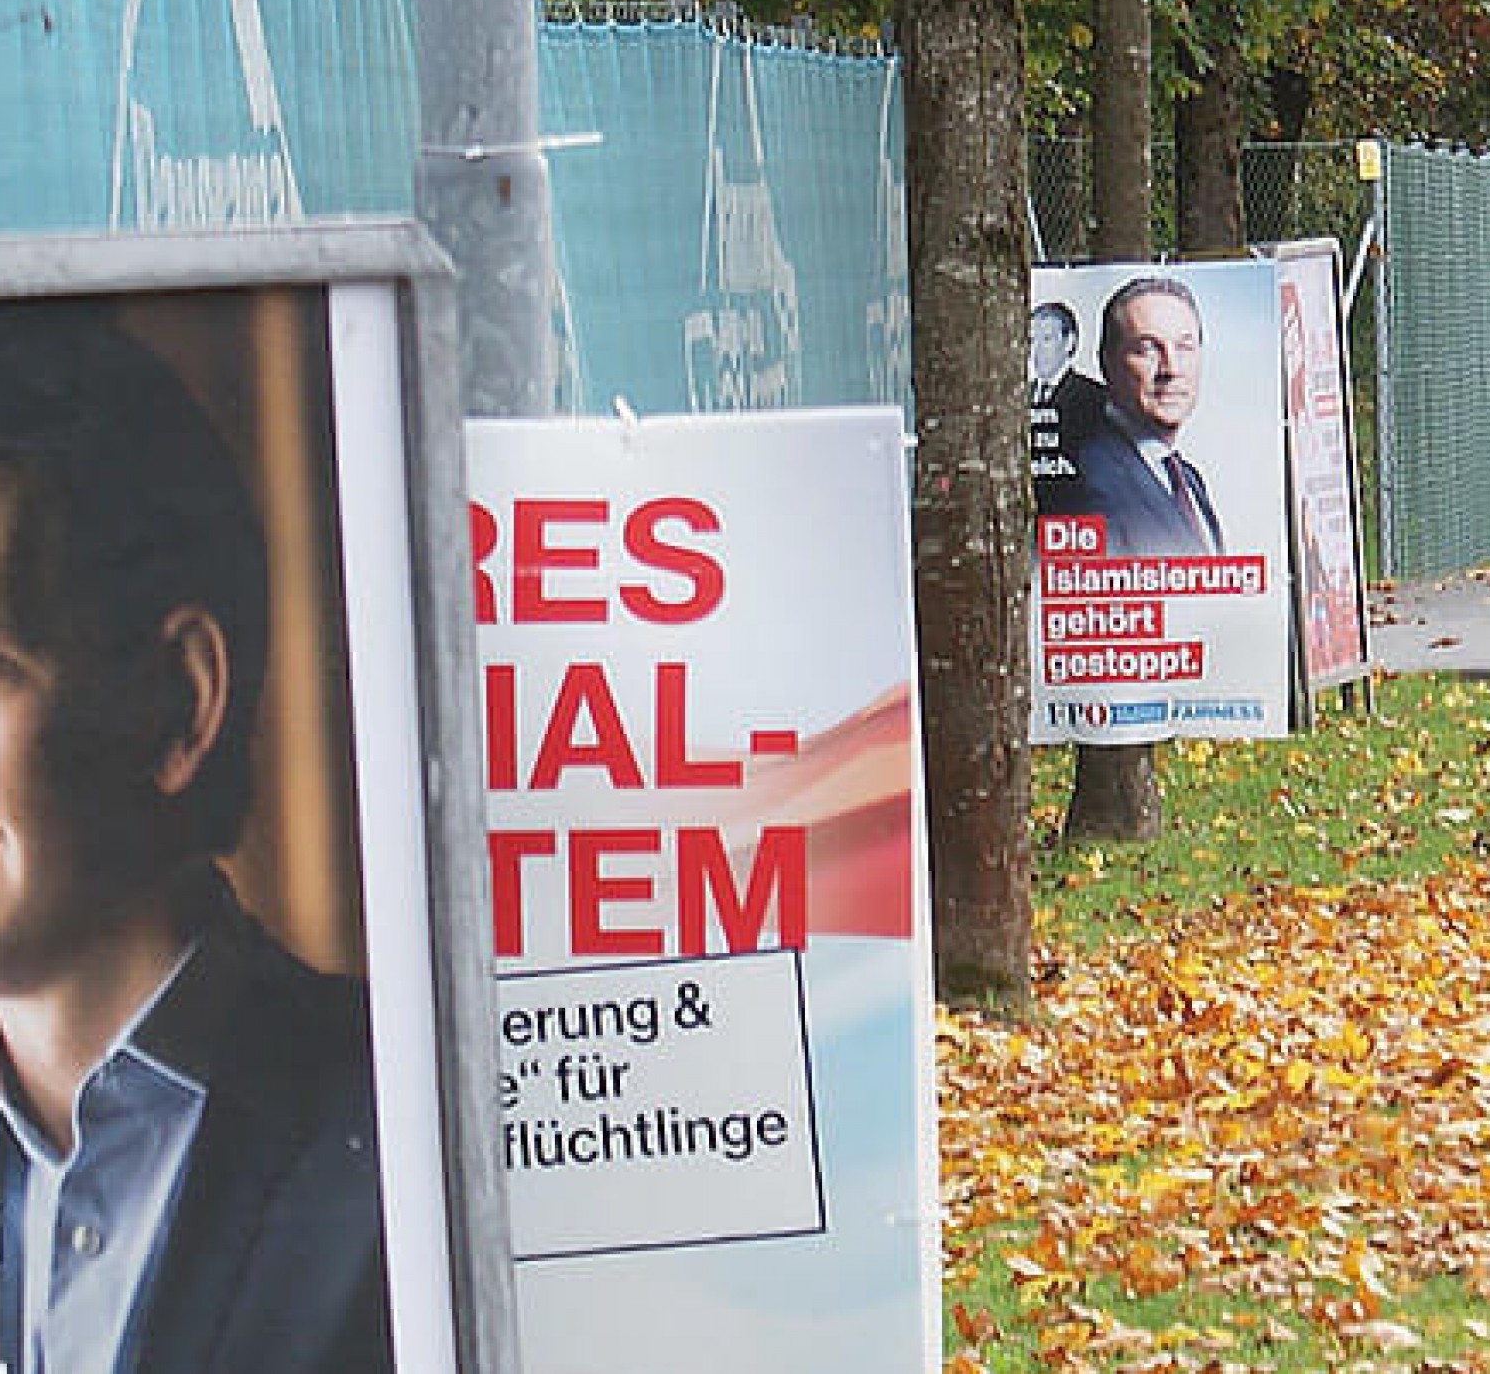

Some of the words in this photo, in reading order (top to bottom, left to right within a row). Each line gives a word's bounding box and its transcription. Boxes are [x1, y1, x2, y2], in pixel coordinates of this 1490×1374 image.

[1044, 521, 1097, 551] Die
[1047, 561, 1259, 594] Islamisierung
[1048, 602, 1155, 639] gehört
[1050, 648, 1199, 680] gestoppt.
[485, 662, 799, 790] IAL-
[487, 825, 807, 957] TEM
[502, 997, 659, 1045] erung
[674, 982, 712, 1029] &
[556, 1052, 630, 1103] für
[505, 1106, 789, 1169] flüchtlinge
